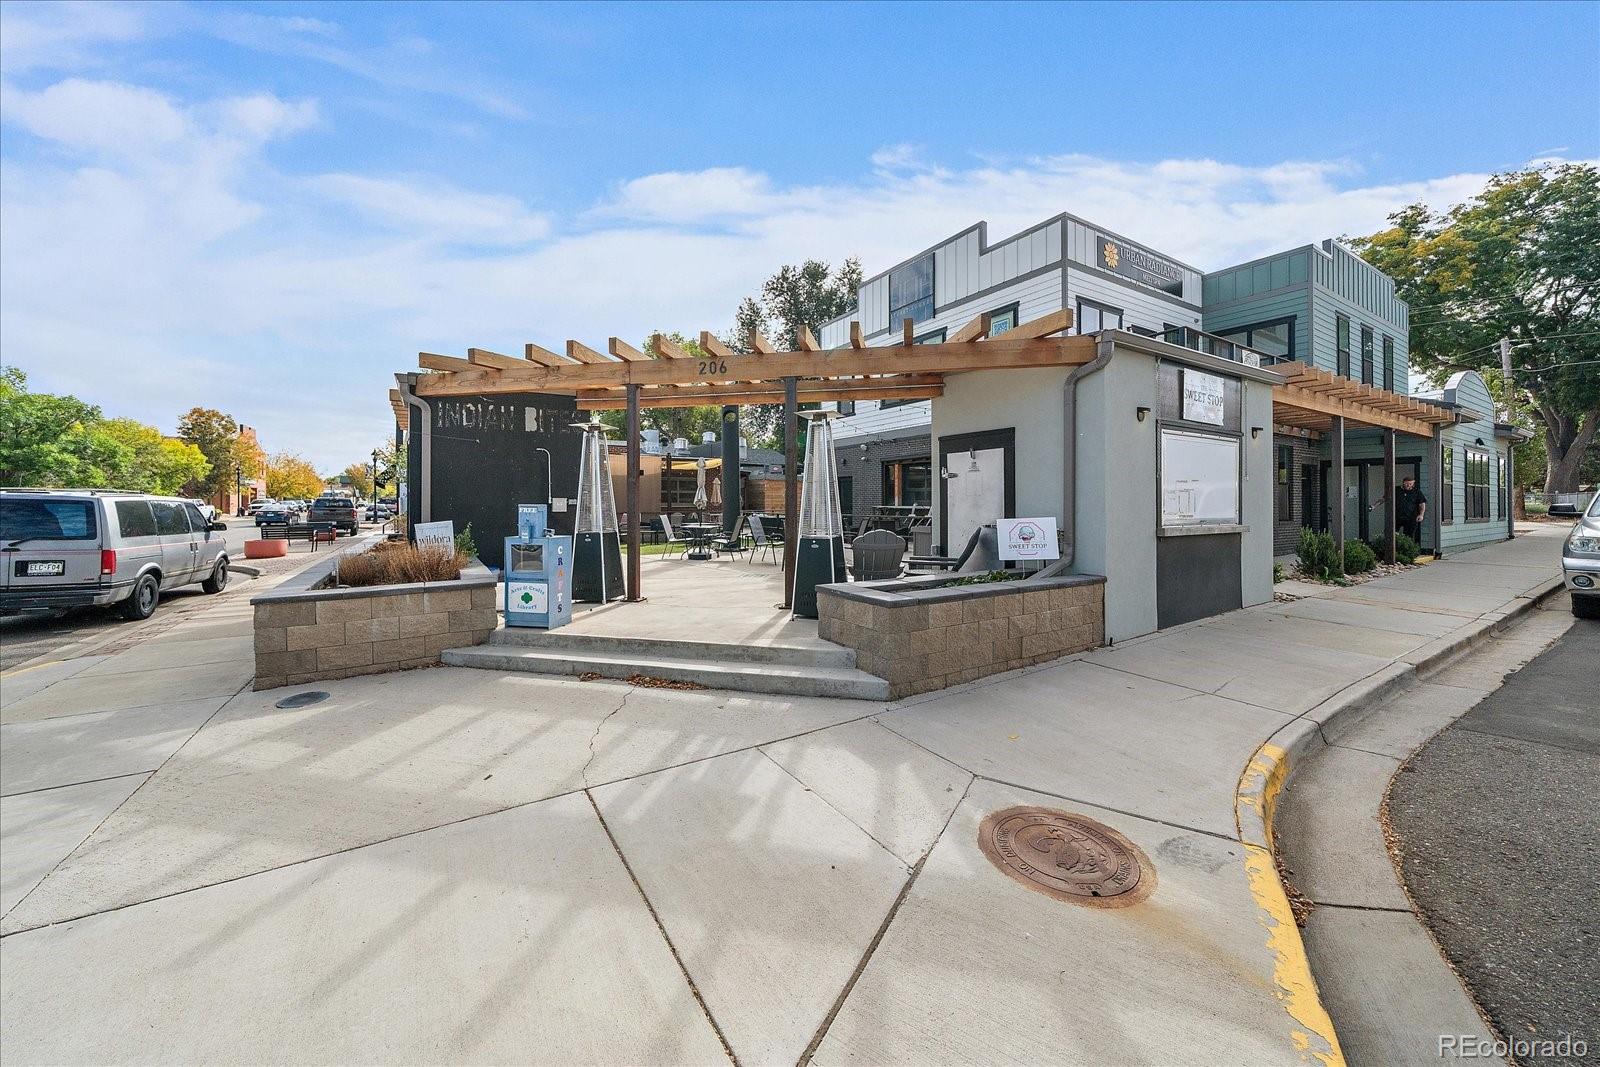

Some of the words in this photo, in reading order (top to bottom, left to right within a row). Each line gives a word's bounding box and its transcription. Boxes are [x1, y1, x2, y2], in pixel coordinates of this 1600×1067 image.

[1120, 247, 1146, 267] URBAN
[699, 361, 727, 375] 206
[1184, 389, 1206, 403] SWEET
[1207, 394, 1223, 407] STOP
[437, 400, 515, 432] INDIAN
[418, 534, 451, 545] wildora
